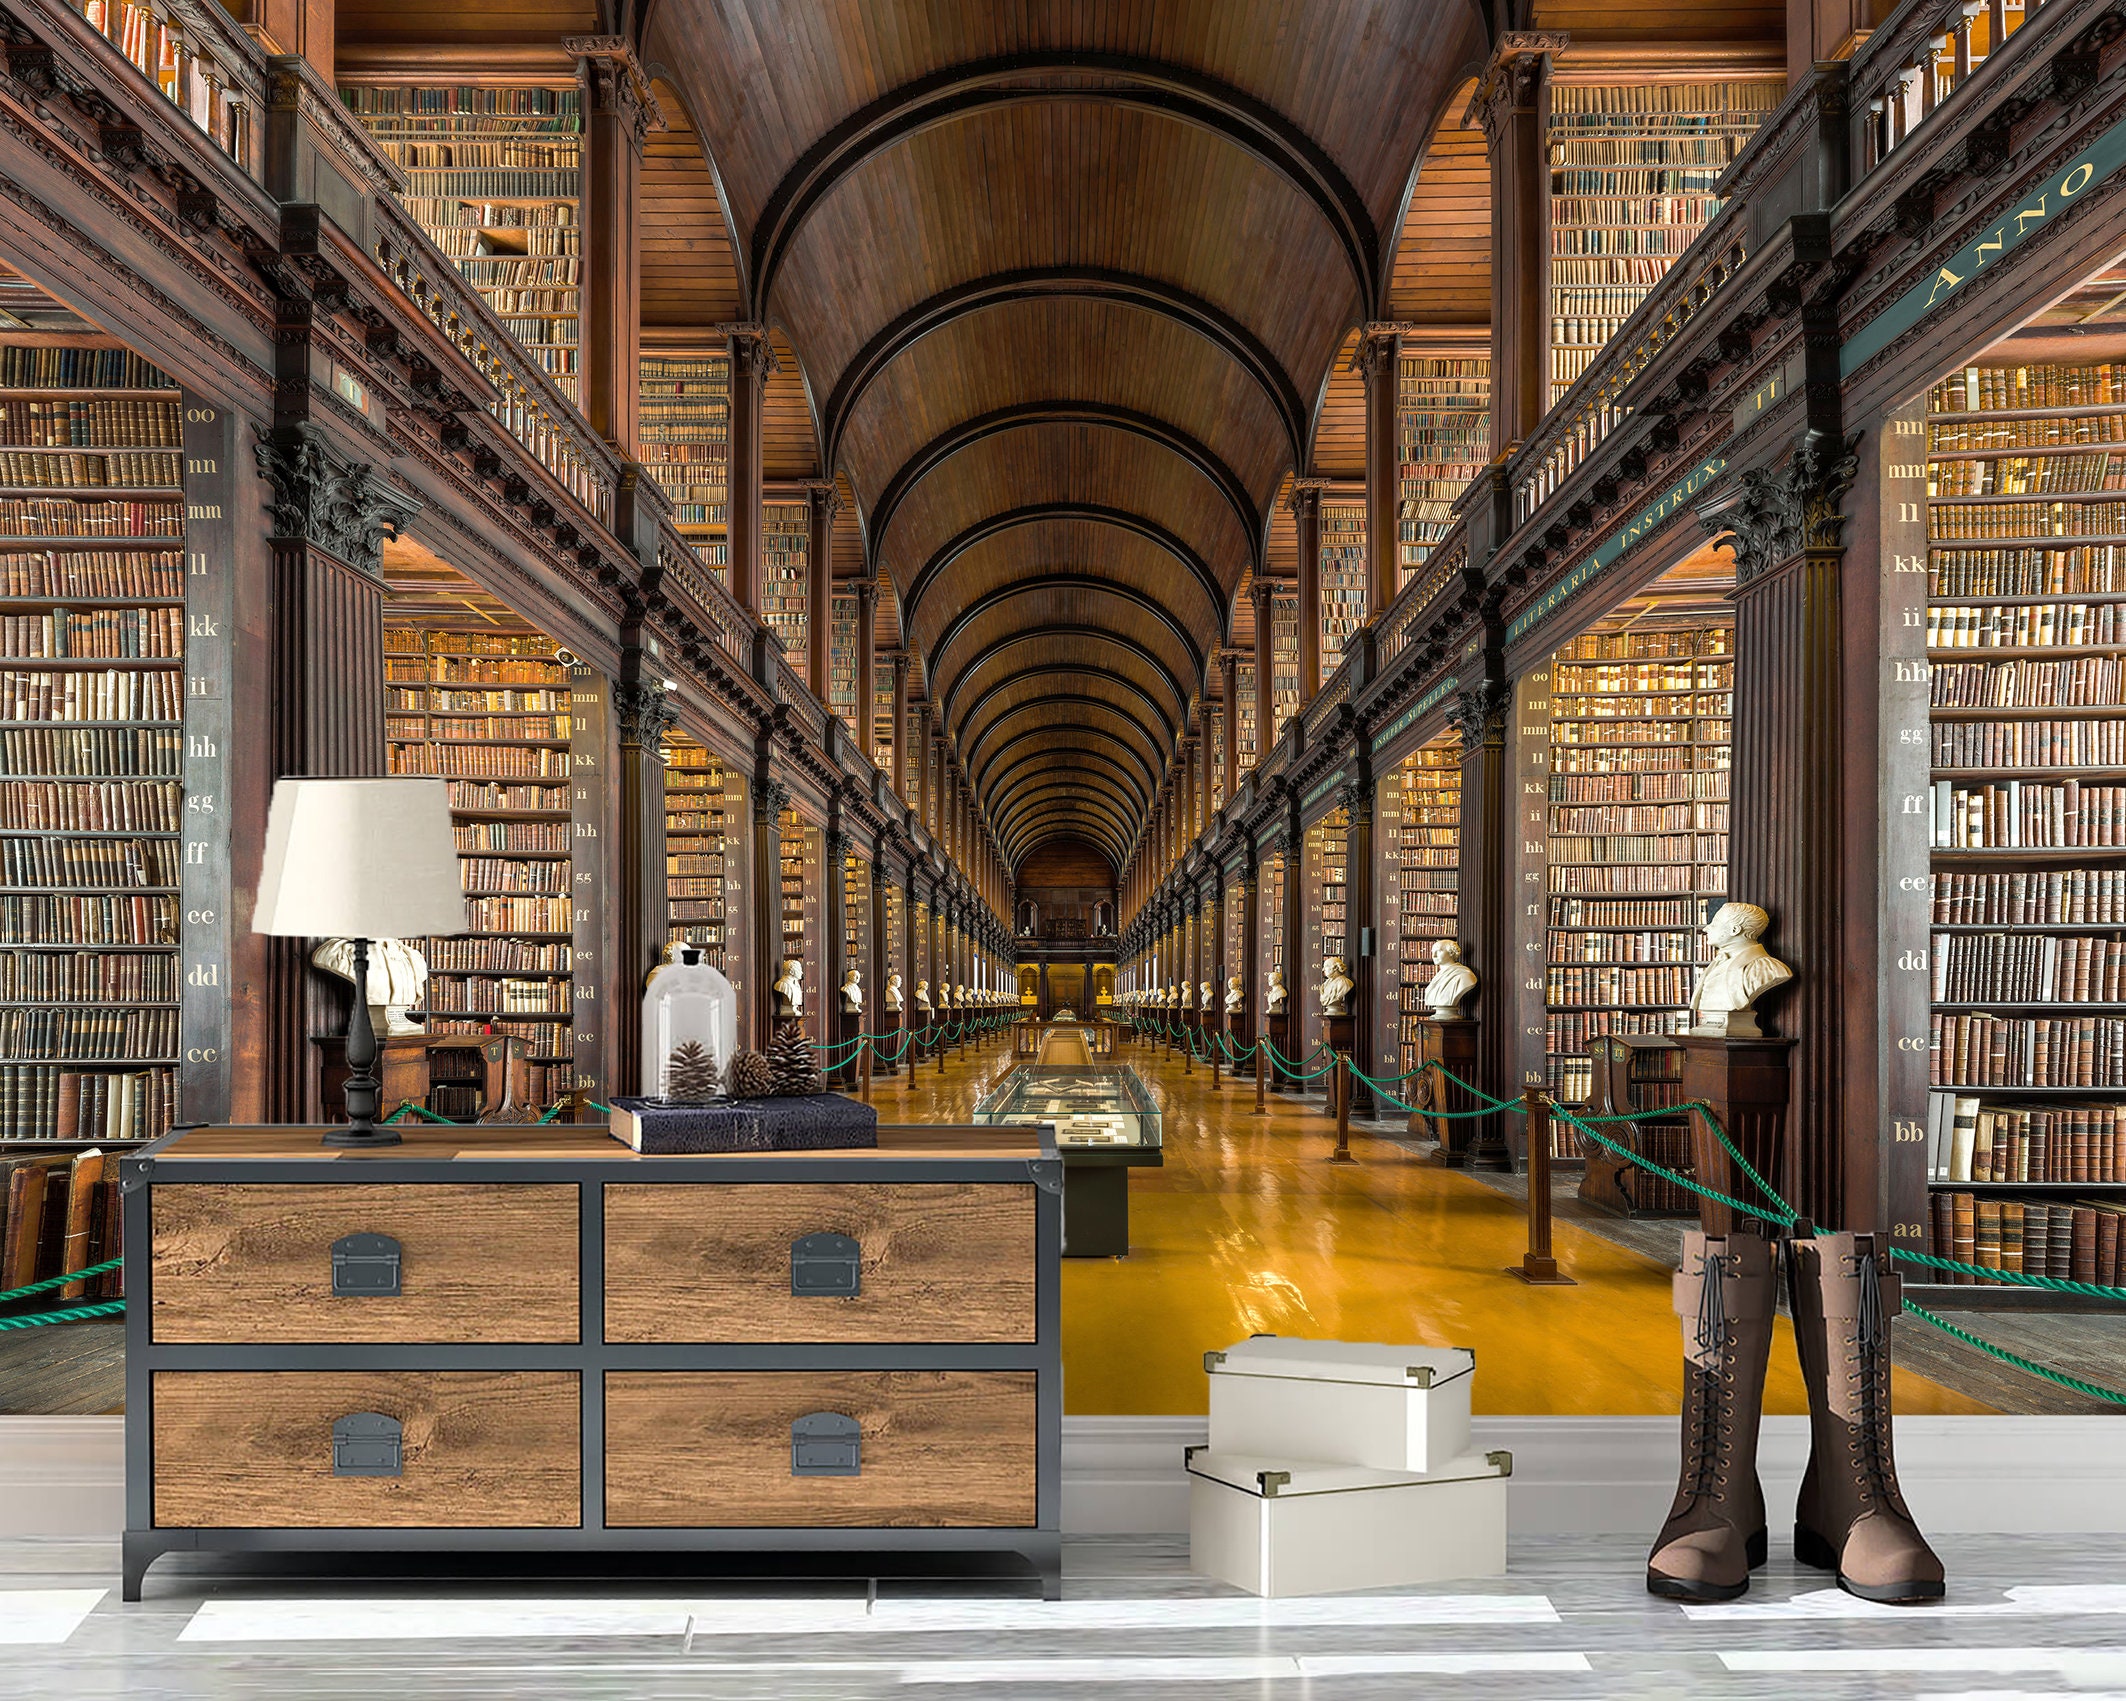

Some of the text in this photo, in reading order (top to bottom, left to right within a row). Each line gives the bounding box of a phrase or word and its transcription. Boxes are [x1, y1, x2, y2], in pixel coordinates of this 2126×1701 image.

[1923, 162, 2095, 309] ANNO
[1752, 376, 1780, 410] TT
[187, 409, 214, 422] oo
[1895, 421, 1924, 437] nn
[189, 460, 216, 473] nn
[1889, 465, 1926, 478] mm
[189, 506, 222, 519] mm
[1899, 503, 1919, 522] ll
[191, 554, 206, 574] ll
[1894, 555, 1926, 573] kk
[1514, 558, 1601, 636] LITERARIA
[1903, 608, 1921, 626] ii
[190, 615, 218, 636] kk
[574, 667, 591, 675] nn
[1533, 673, 1548, 681] oo
[1895, 662, 1928, 681] hh
[190, 677, 206, 695] ii
[573, 694, 597, 702] mm
[1529, 701, 1546, 709] nn
[576, 718, 586, 730] ll
[1375, 718, 1404, 749] INSUPER
[1901, 730, 1923, 745] gg
[189, 736, 215, 757] hh
[575, 755, 594, 765] kk
[1533, 753, 1542, 763] ll
[577, 788, 586, 799] ii
[1525, 783, 1544, 793] kk
[188, 795, 213, 813] gg
[1902, 795, 1923, 813] ff
[727, 815, 734, 823] ll
[1531, 810, 1540, 821] ii
[576, 823, 596, 837] hh
[1389, 829, 1396, 838] ll
[727, 837, 740, 845] kk
[1526, 841, 1543, 853] hh
[186, 842, 208, 864] ff
[576, 873, 591, 883] gg
[1390, 873, 1396, 881] ii
[1525, 873, 1539, 881] gg
[727, 880, 741, 890] hh
[1900, 877, 1925, 891] ee
[1387, 896, 1398, 904] hh
[576, 909, 589, 921] ff
[1528, 904, 1539, 915] ff
[188, 910, 214, 924] ee
[1526, 943, 1541, 951] ee
[577, 952, 592, 960] ee
[1898, 950, 1927, 970] dd
[188, 964, 217, 986] dd
[1526, 978, 1542, 989] dd
[576, 986, 594, 999] dd
[1386, 992, 1398, 1000] dd
[578, 1034, 593, 1042] cc
[1899, 1037, 1925, 1051] cc
[187, 1048, 217, 1062] cc
[1384, 1055, 1395, 1063] bb
[579, 1075, 595, 1088] bb
[1526, 1071, 1541, 1083] bb
[1894, 1122, 1923, 1142] bb
[1894, 1223, 1921, 1237] aa
